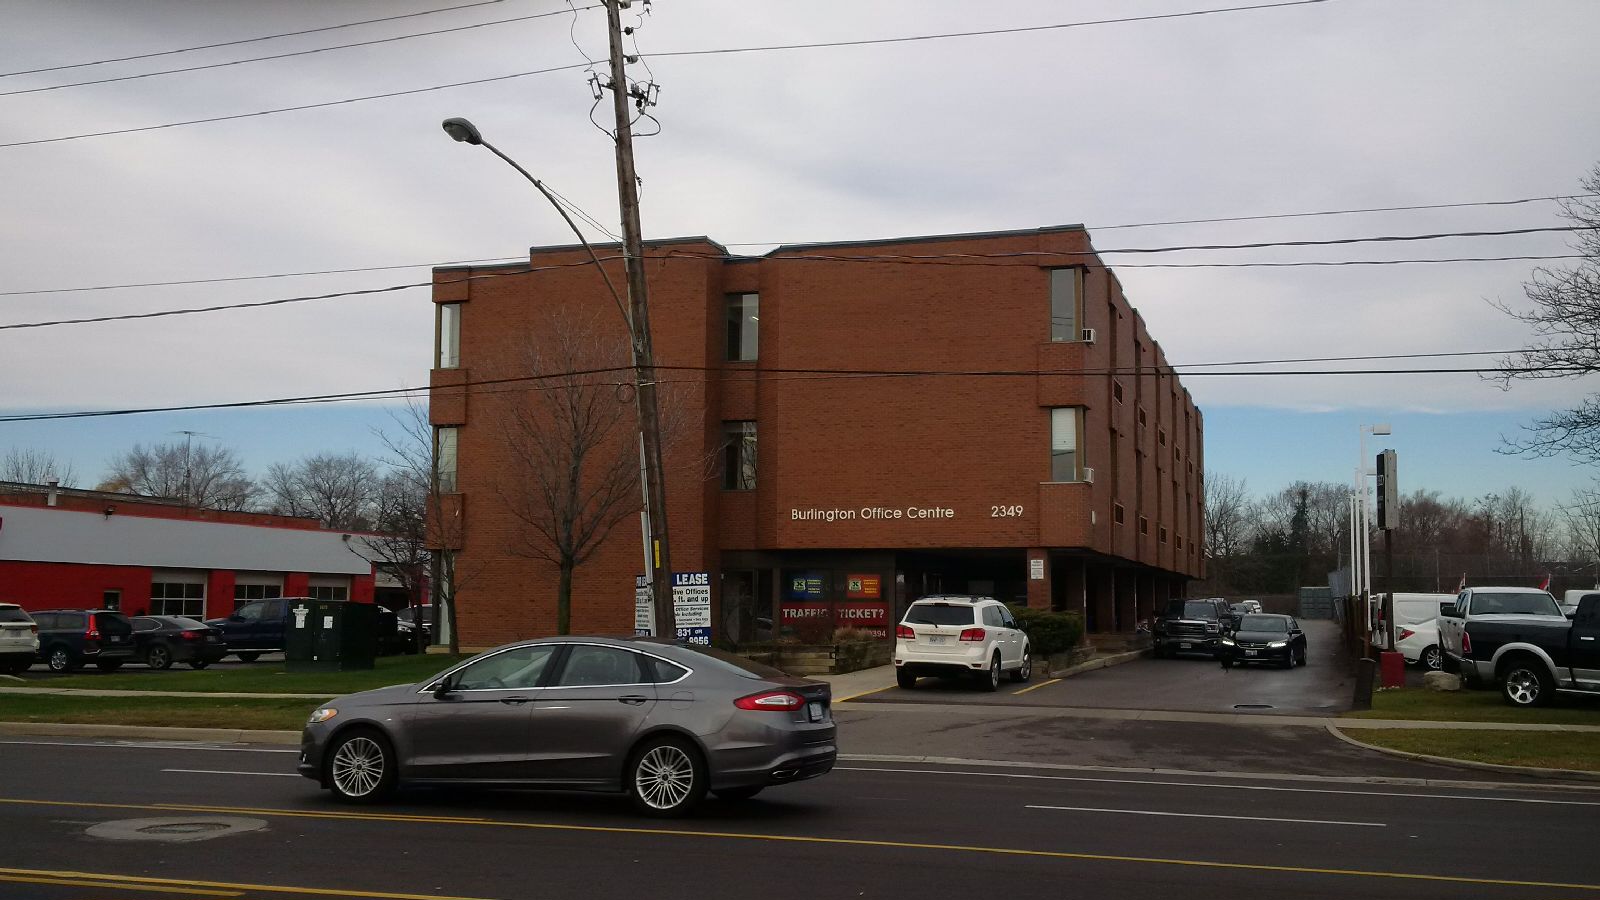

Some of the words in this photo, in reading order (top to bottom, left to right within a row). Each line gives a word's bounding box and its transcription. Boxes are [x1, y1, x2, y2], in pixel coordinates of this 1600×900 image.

[791, 508, 856, 522] Burlington
[861, 507, 902, 519] Office
[907, 506, 955, 519] Centre
[991, 504, 1024, 518] 2349
[676, 573, 708, 585] LEASE
[837, 608, 884, 619] TICKET?
